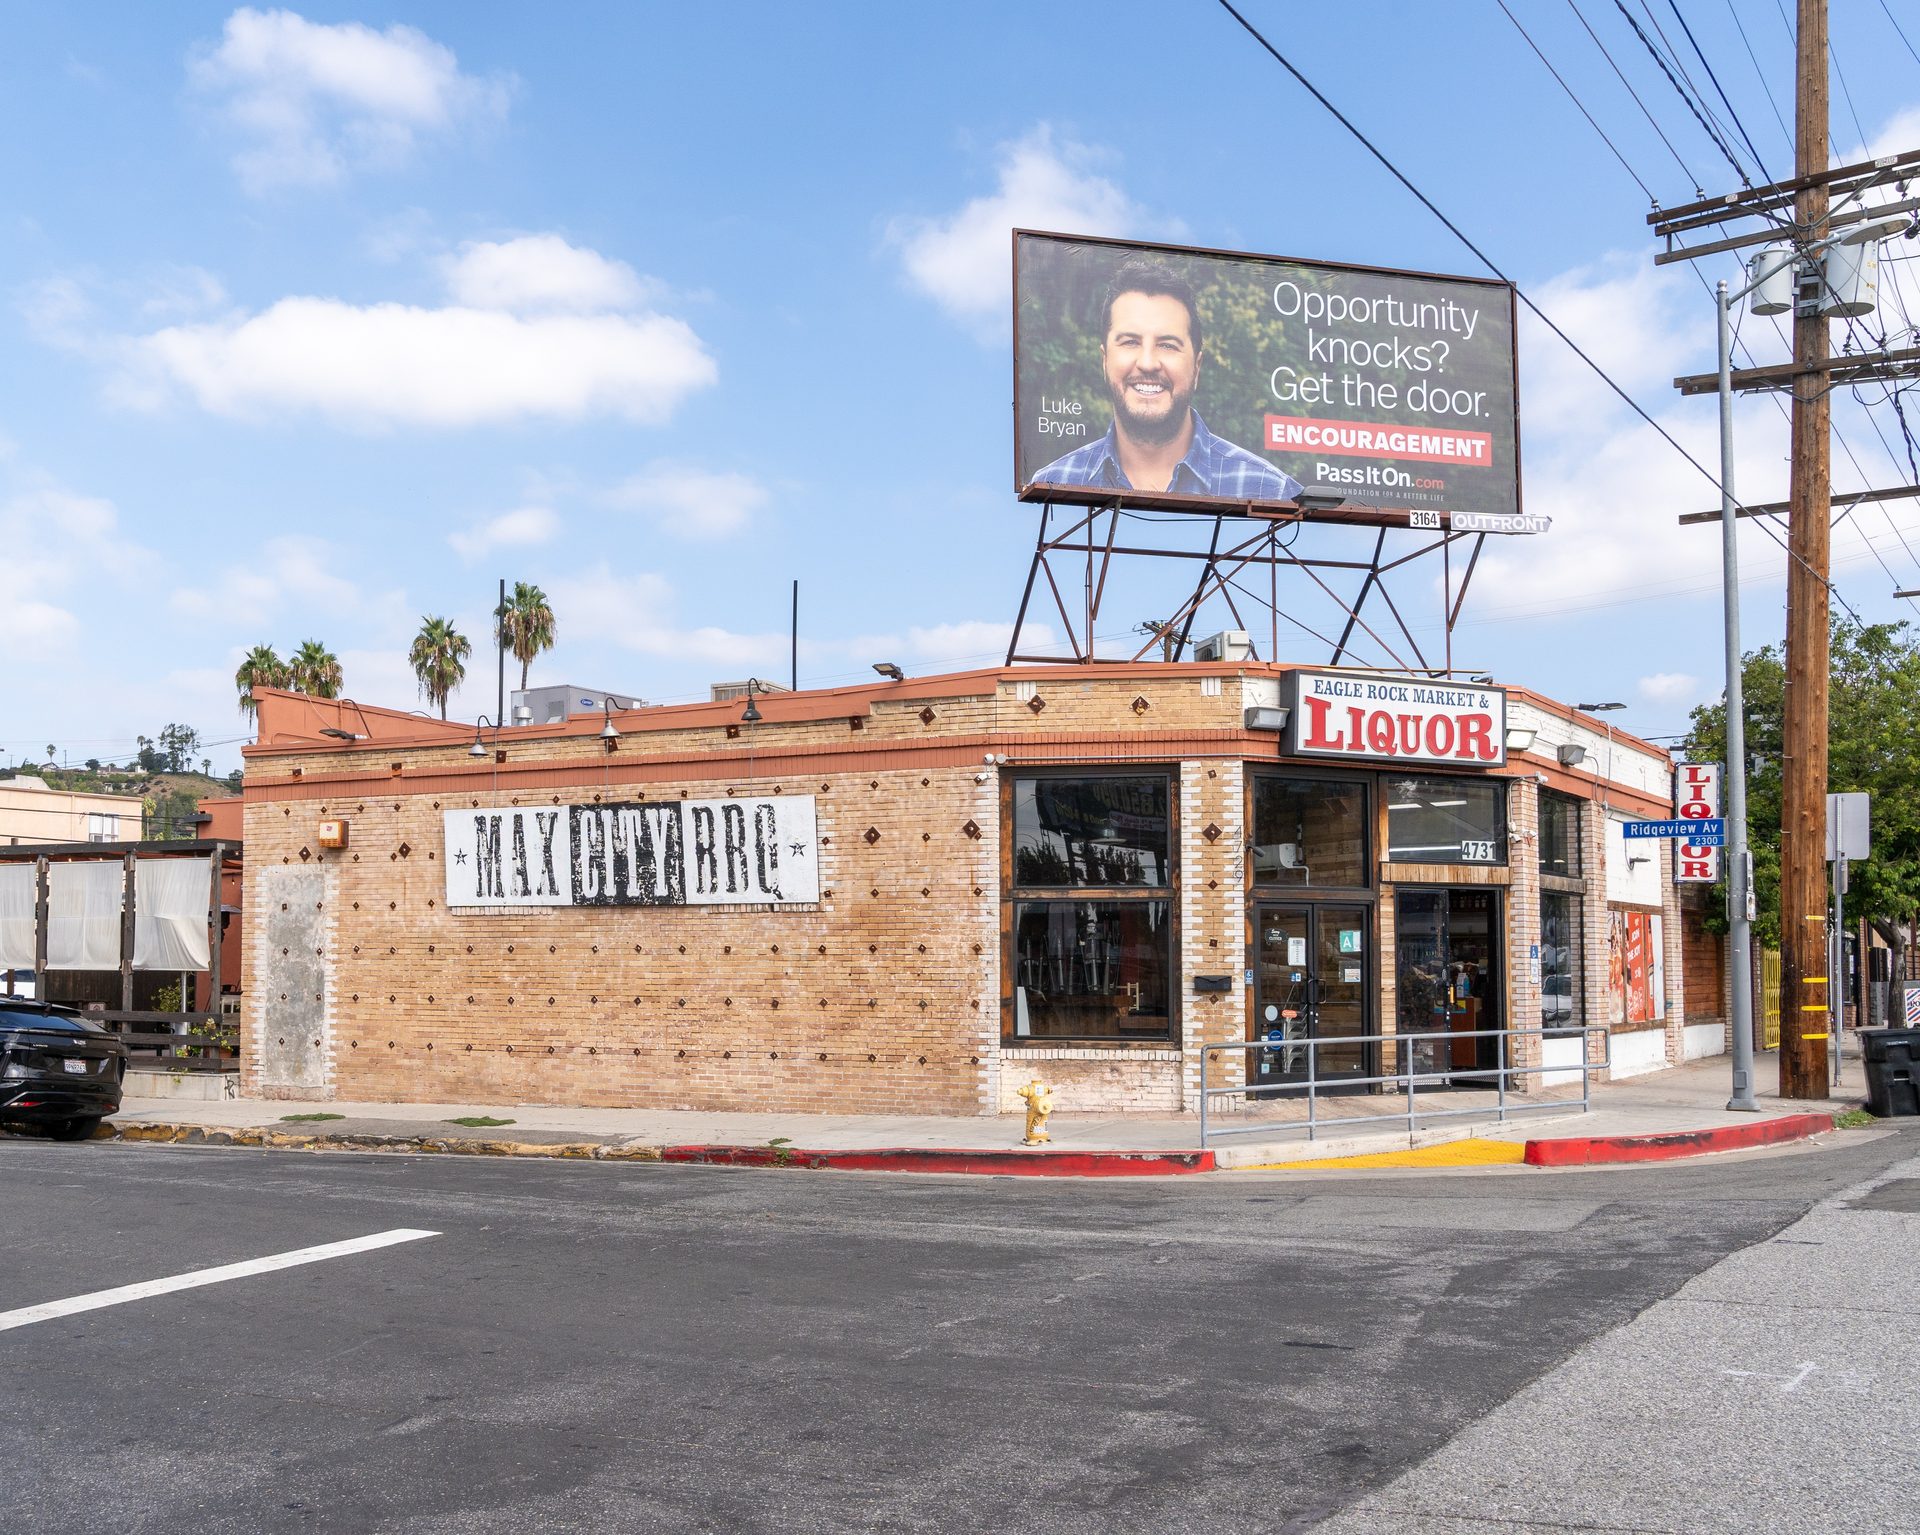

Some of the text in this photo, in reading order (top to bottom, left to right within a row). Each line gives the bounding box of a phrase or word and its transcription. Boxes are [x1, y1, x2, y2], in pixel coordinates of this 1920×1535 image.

[1273, 281, 1479, 340] Opportunity
[1308, 328, 1450, 373] knocks?
[1270, 366, 1490, 418] Get the door.
[1042, 396, 1082, 415] Luke
[1038, 416, 1086, 438] Bryan
[1271, 423, 1486, 458] ENCOURAGEMENT
[1337, 487, 1380, 497] OUNDATION
[1412, 511, 1437, 526] 3164
[1454, 513, 1549, 531] OUTFRONT
[1314, 679, 1489, 709] EAGLE ROCK MARKET &
[1303, 695, 1499, 760] LIQUOR
[1631, 822, 1718, 836] Ridgeview Av
[1680, 767, 1713, 878] LIQOR
[474, 802, 784, 900] MAX CITY BBQ
[1461, 842, 1496, 860] 4731
[1695, 837, 1718, 845] 2300
[1343, 936, 1352, 948] A
